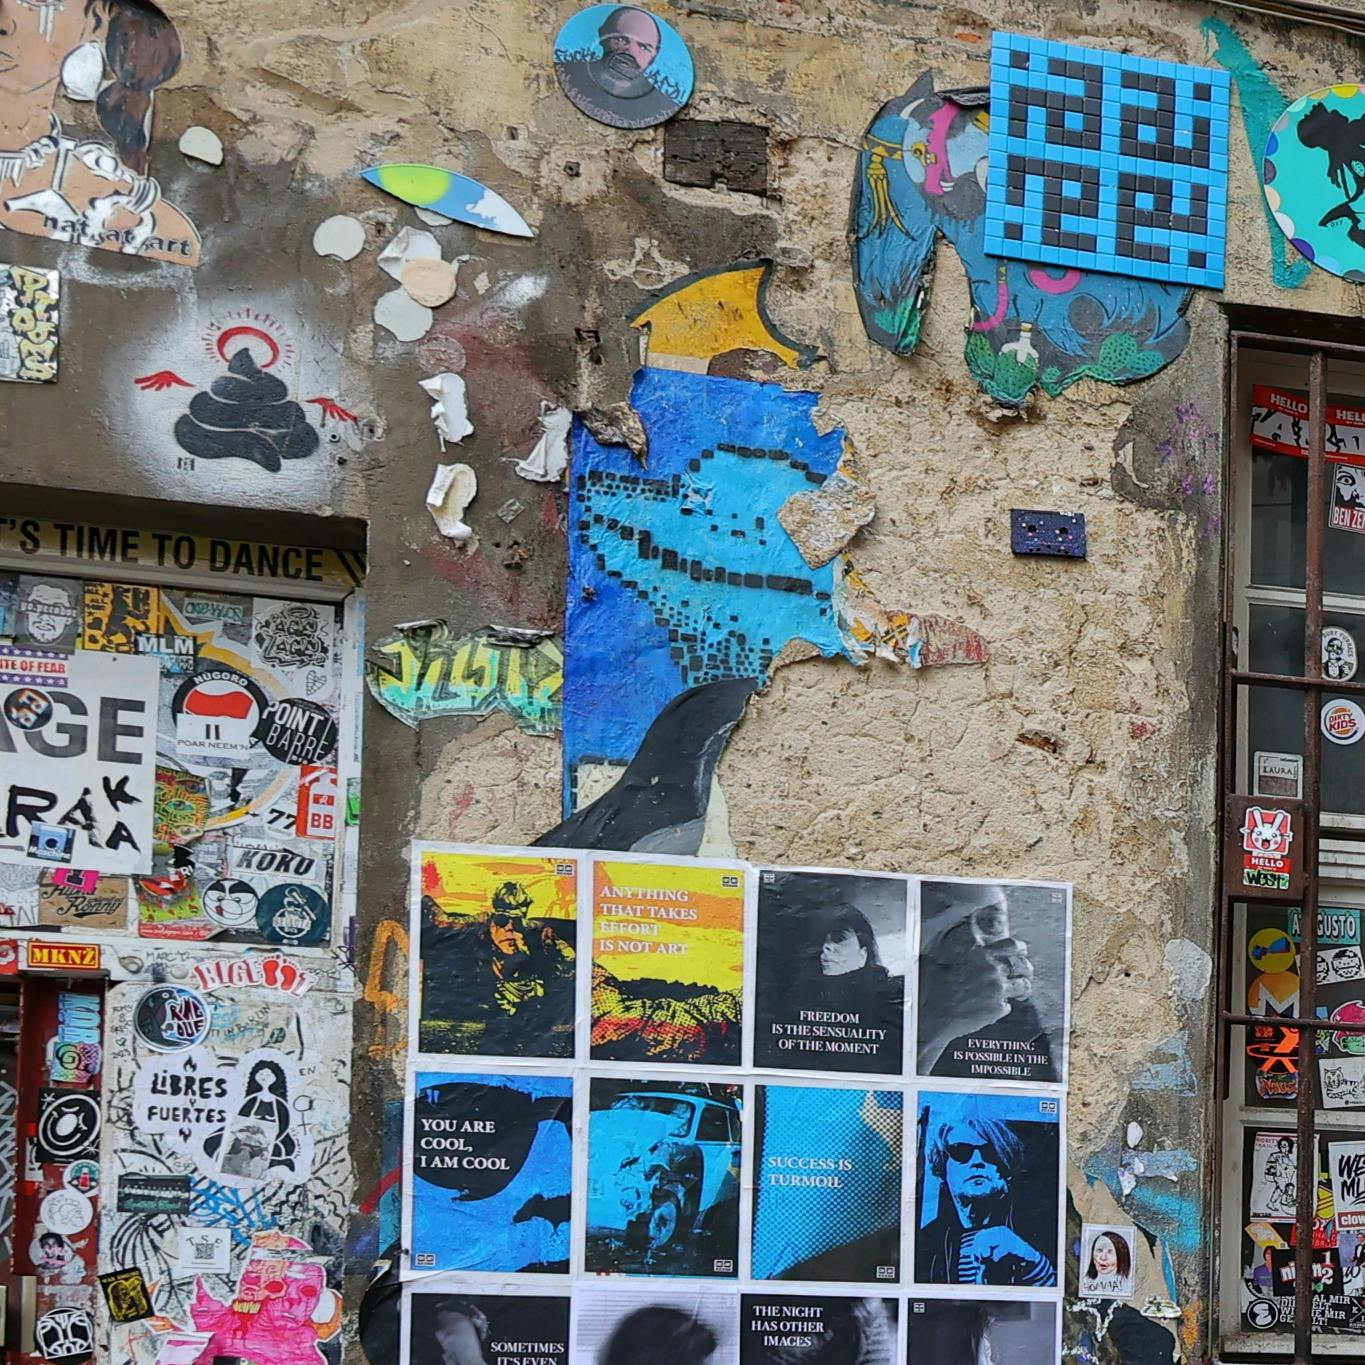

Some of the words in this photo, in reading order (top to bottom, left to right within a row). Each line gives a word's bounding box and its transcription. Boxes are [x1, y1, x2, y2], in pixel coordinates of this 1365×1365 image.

[1270, 393, 1308, 414] HELLO
[1333, 506, 1350, 527] BEN
[54, 523, 139, 564] TIME
[152, 533, 196, 570] TO
[210, 540, 325, 581] DANCE
[138, 634, 193, 655] MLM
[37, 661, 66, 674] FEAR
[1328, 718, 1357, 731] KIDS
[1250, 858, 1284, 869] HELLO
[599, 885, 689, 902] ANYTHING
[600, 903, 645, 918] THAT
[649, 906, 698, 921] TAKES
[600, 921, 660, 937] EFFORT
[600, 939, 615, 953] IS
[619, 940, 653, 954] NOT
[656, 943, 689, 957] ART
[799, 1009, 860, 1024] FREEDOM
[771, 1023, 784, 1035] IS
[786, 1024, 811, 1037] THE
[812, 1025, 887, 1041] SENSUALITY
[778, 1039, 796, 1051] OF
[797, 1041, 824, 1053] THE
[826, 1042, 880, 1055] MOMENT
[965, 1051, 1010, 1064] POSSIBLE
[1026, 1054, 1048, 1066] THE
[971, 1064, 1032, 1077] IMPOSSIBLE
[147, 1106, 227, 1123] FUERTES
[420, 1118, 457, 1132] YOU
[462, 1120, 496, 1134] ARE
[420, 1136, 473, 1153] COOL,
[430, 1155, 459, 1169] AM
[462, 1157, 510, 1171] COOL
[768, 1156, 833, 1171] SUCCESS
[837, 1159, 854, 1172] IS
[768, 1173, 843, 1189] TURMOIL
[752, 1305, 780, 1318] THE
[782, 1306, 824, 1319] NIGHT
[750, 1320, 778, 1332] HAS
[780, 1321, 825, 1334] OTHER
[490, 1342, 565, 1354] SOMETIMES
[762, 1335, 813, 1348] IMAGES
